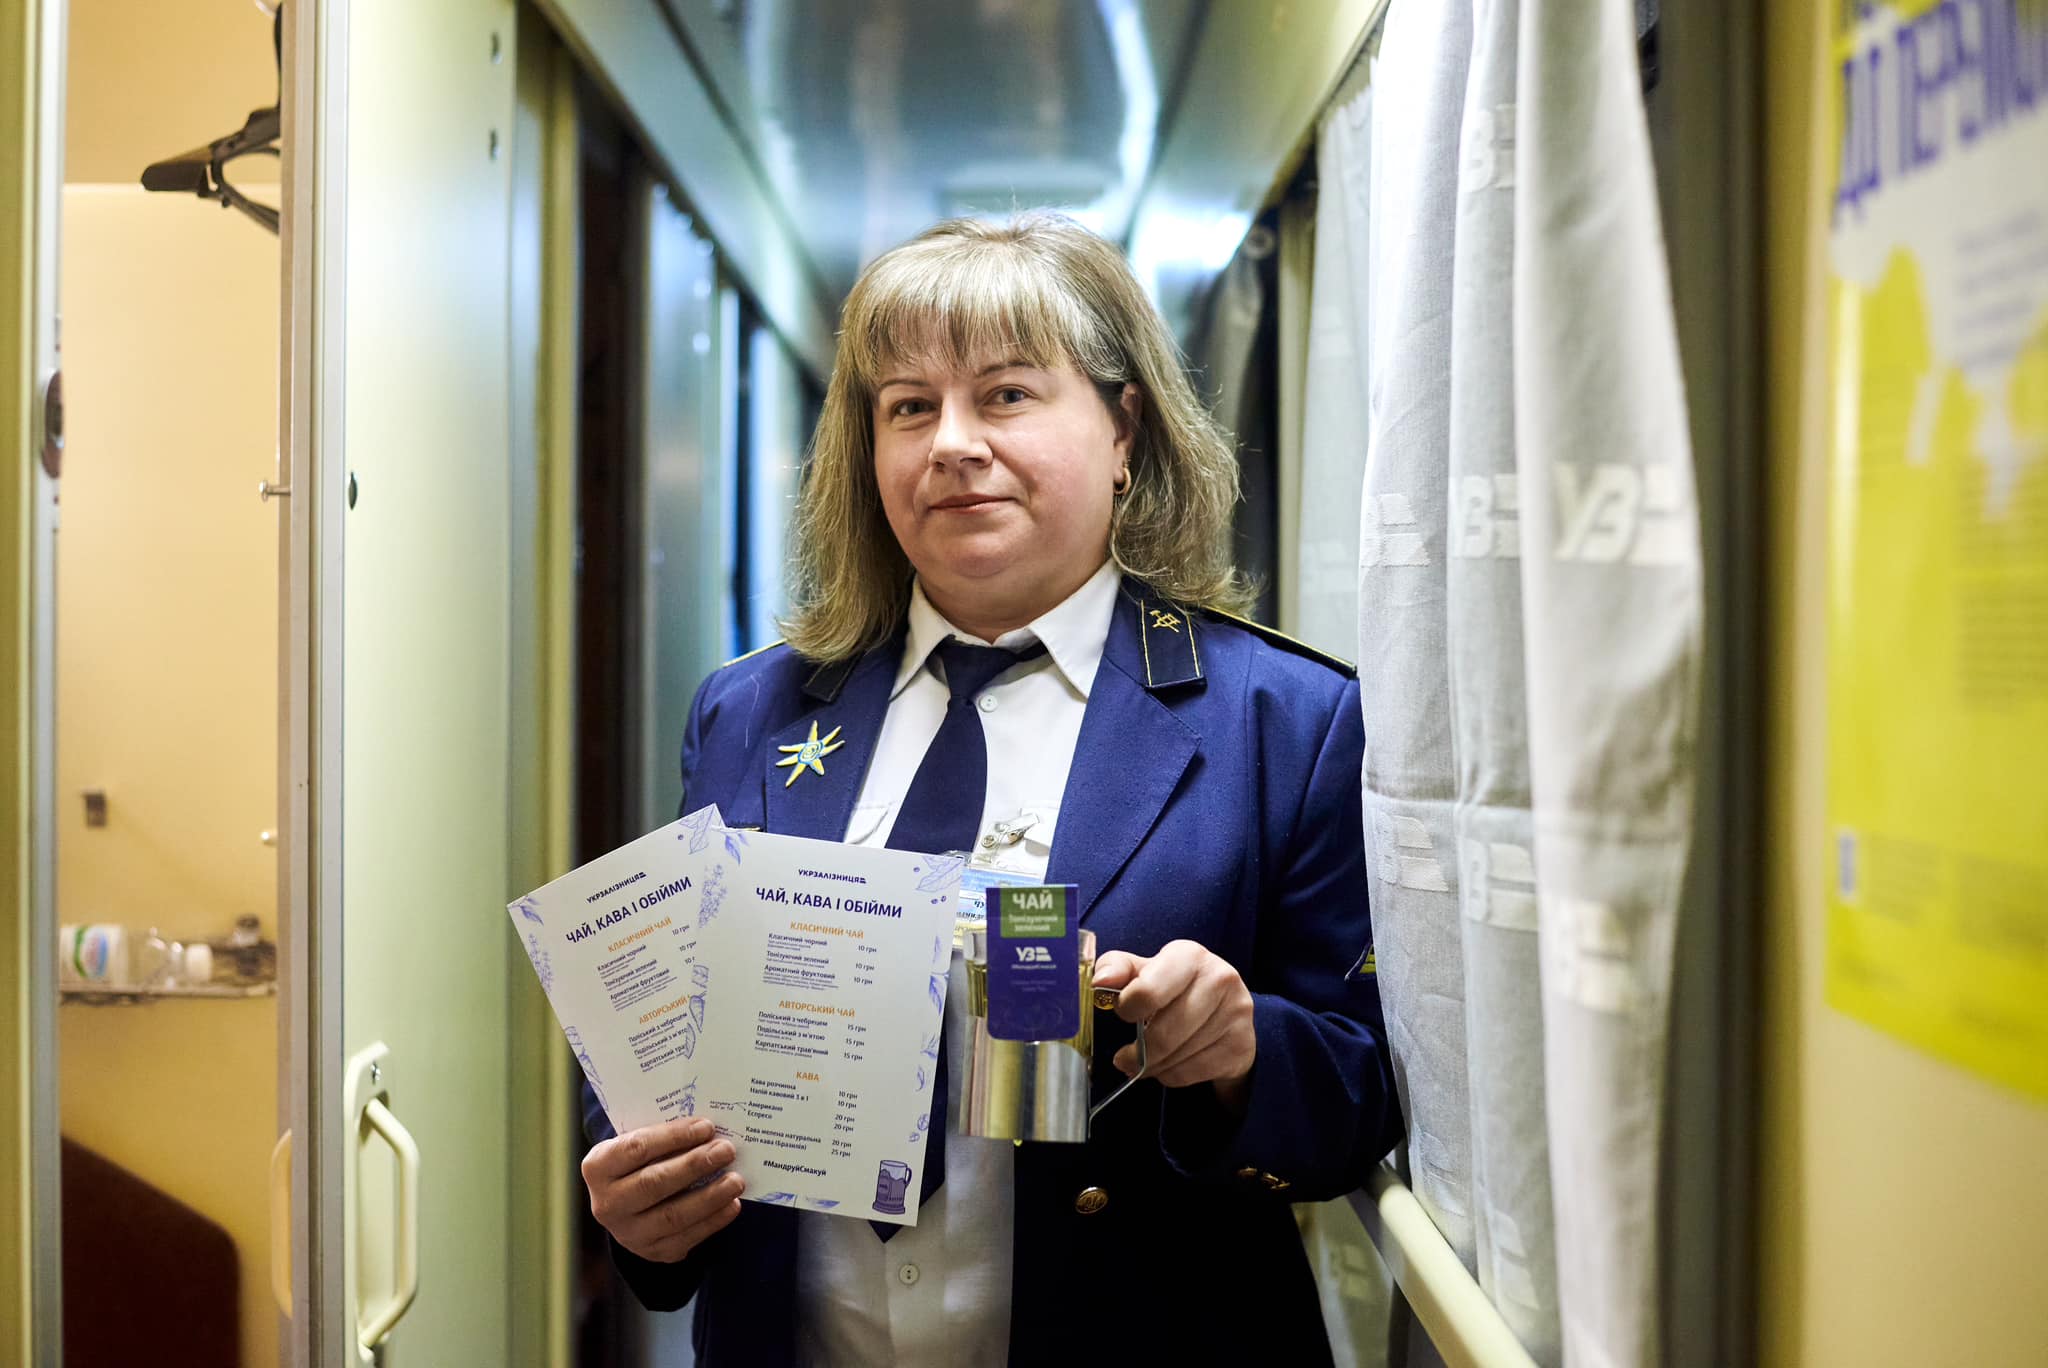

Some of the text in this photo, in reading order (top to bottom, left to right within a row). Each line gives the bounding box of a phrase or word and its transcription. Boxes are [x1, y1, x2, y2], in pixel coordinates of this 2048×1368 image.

[798, 869, 859, 883] УКРЗАЛІЗНИЦЯ
[587, 873, 639, 903] УКРЗАЛІЗНИЦЯ
[756, 887, 902, 918] ЧАЙ, КАВА І ОБІЙМИ
[1012, 890, 1053, 910] ЧАЙ
[566, 877, 692, 943] ЧАЙ, КАВА І ОБІЙМИ
[654, 917, 672, 931] ЧАЙ
[679, 924, 690, 934] грн
[790, 921, 864, 939] КЛАСИЧНИЙ ЧАЙ
[866, 946, 877, 954] грн
[1016, 947, 1036, 962] УЗ
[863, 964, 874, 972] грн
[861, 978, 872, 986] грн
[779, 1000, 854, 1018] АВТОРСЬКИЙ ЧАЙ
[756, 1040, 796, 1051] Карпатський
[751, 1078, 766, 1086] Кава
[796, 1072, 820, 1081] КАВА
[846, 1092, 858, 1100] грн
[845, 1102, 856, 1110] грн
[746, 1126, 760, 1134] Кава
[839, 1150, 850, 1158] грн
[763, 1160, 826, 1176] #МандруйСмакуй
